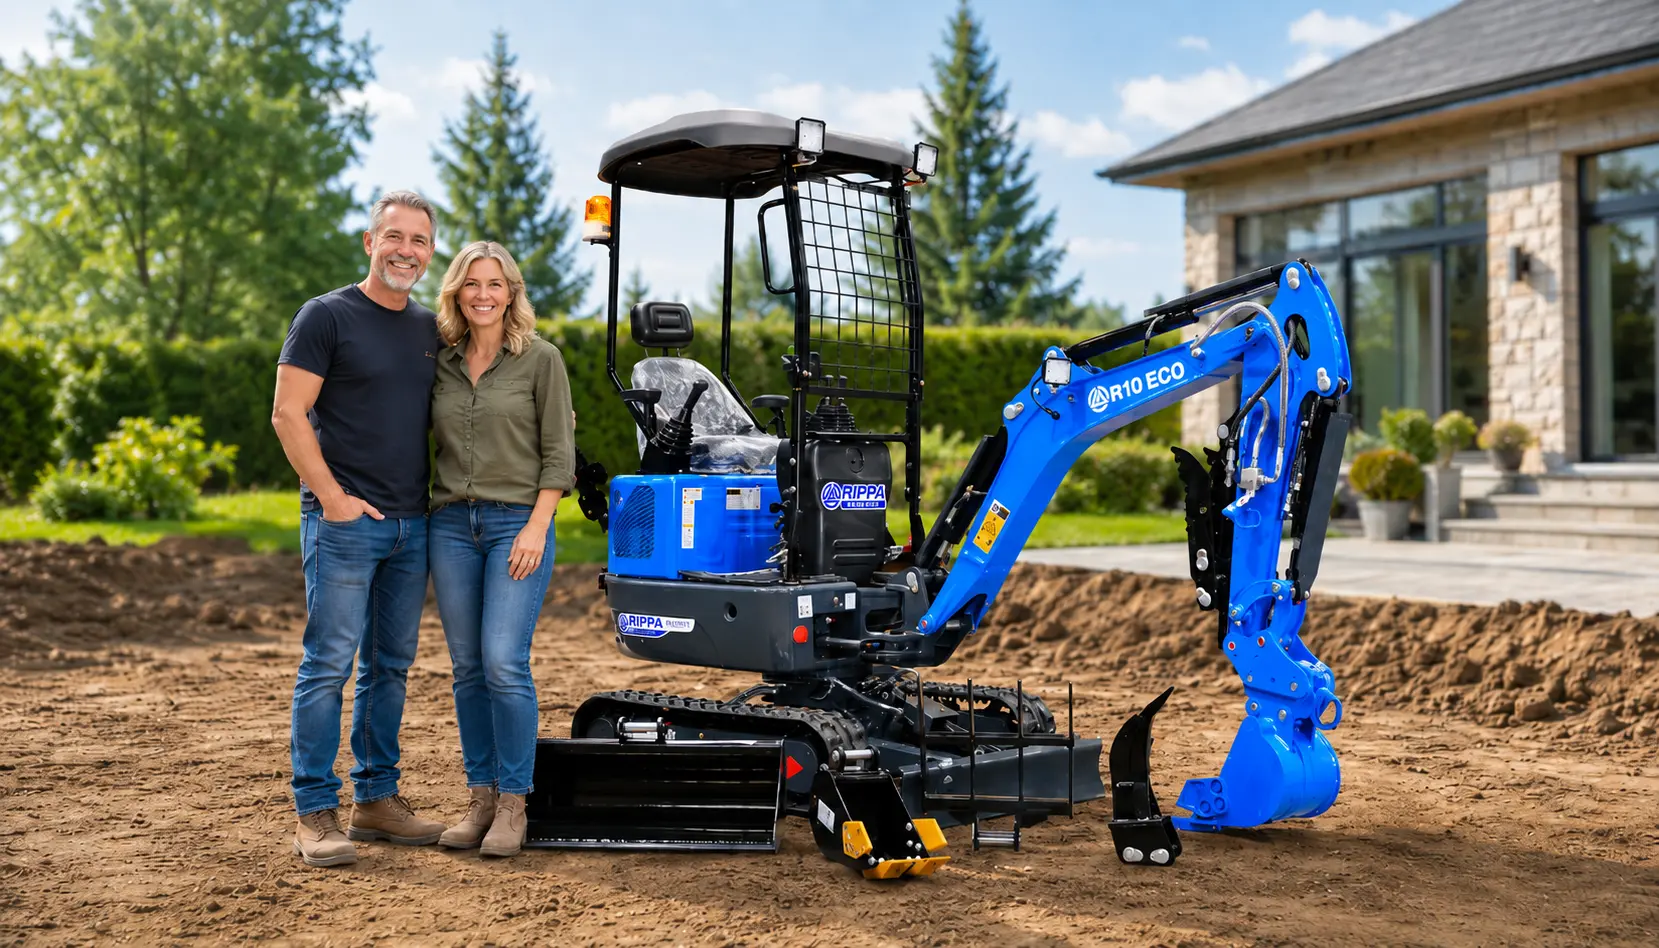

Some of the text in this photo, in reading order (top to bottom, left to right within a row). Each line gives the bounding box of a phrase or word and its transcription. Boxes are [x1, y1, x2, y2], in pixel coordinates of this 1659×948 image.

[1109, 362, 1185, 402] R10 ECO
[842, 485, 885, 499] RIPPA
[629, 615, 663, 629] RIPPA
